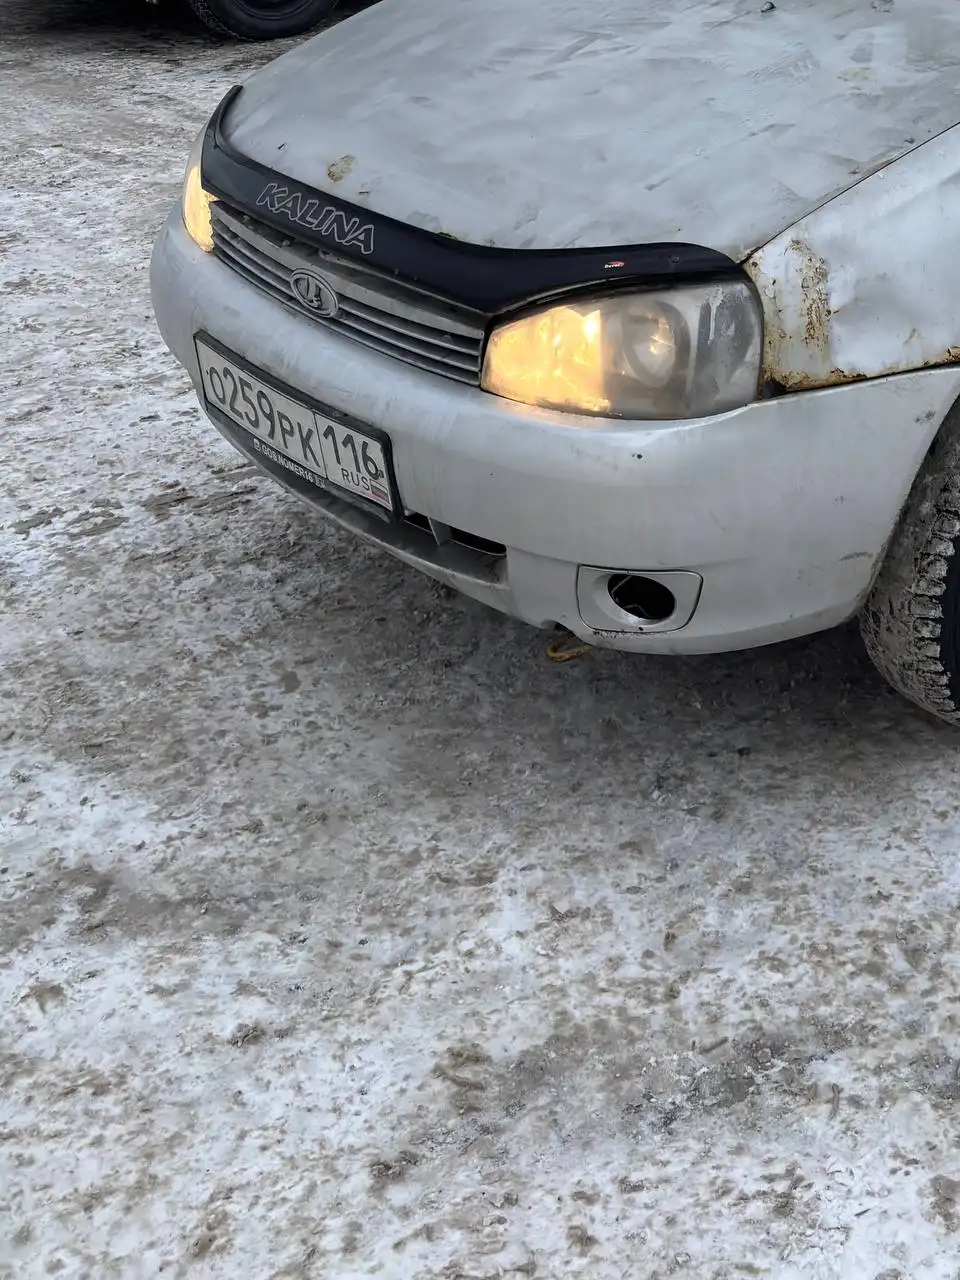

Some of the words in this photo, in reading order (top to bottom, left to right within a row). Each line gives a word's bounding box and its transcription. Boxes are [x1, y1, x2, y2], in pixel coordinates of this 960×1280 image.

[256, 183, 374, 254] KALINA
[322, 425, 380, 480] 116
[341, 468, 370, 491] RUS
